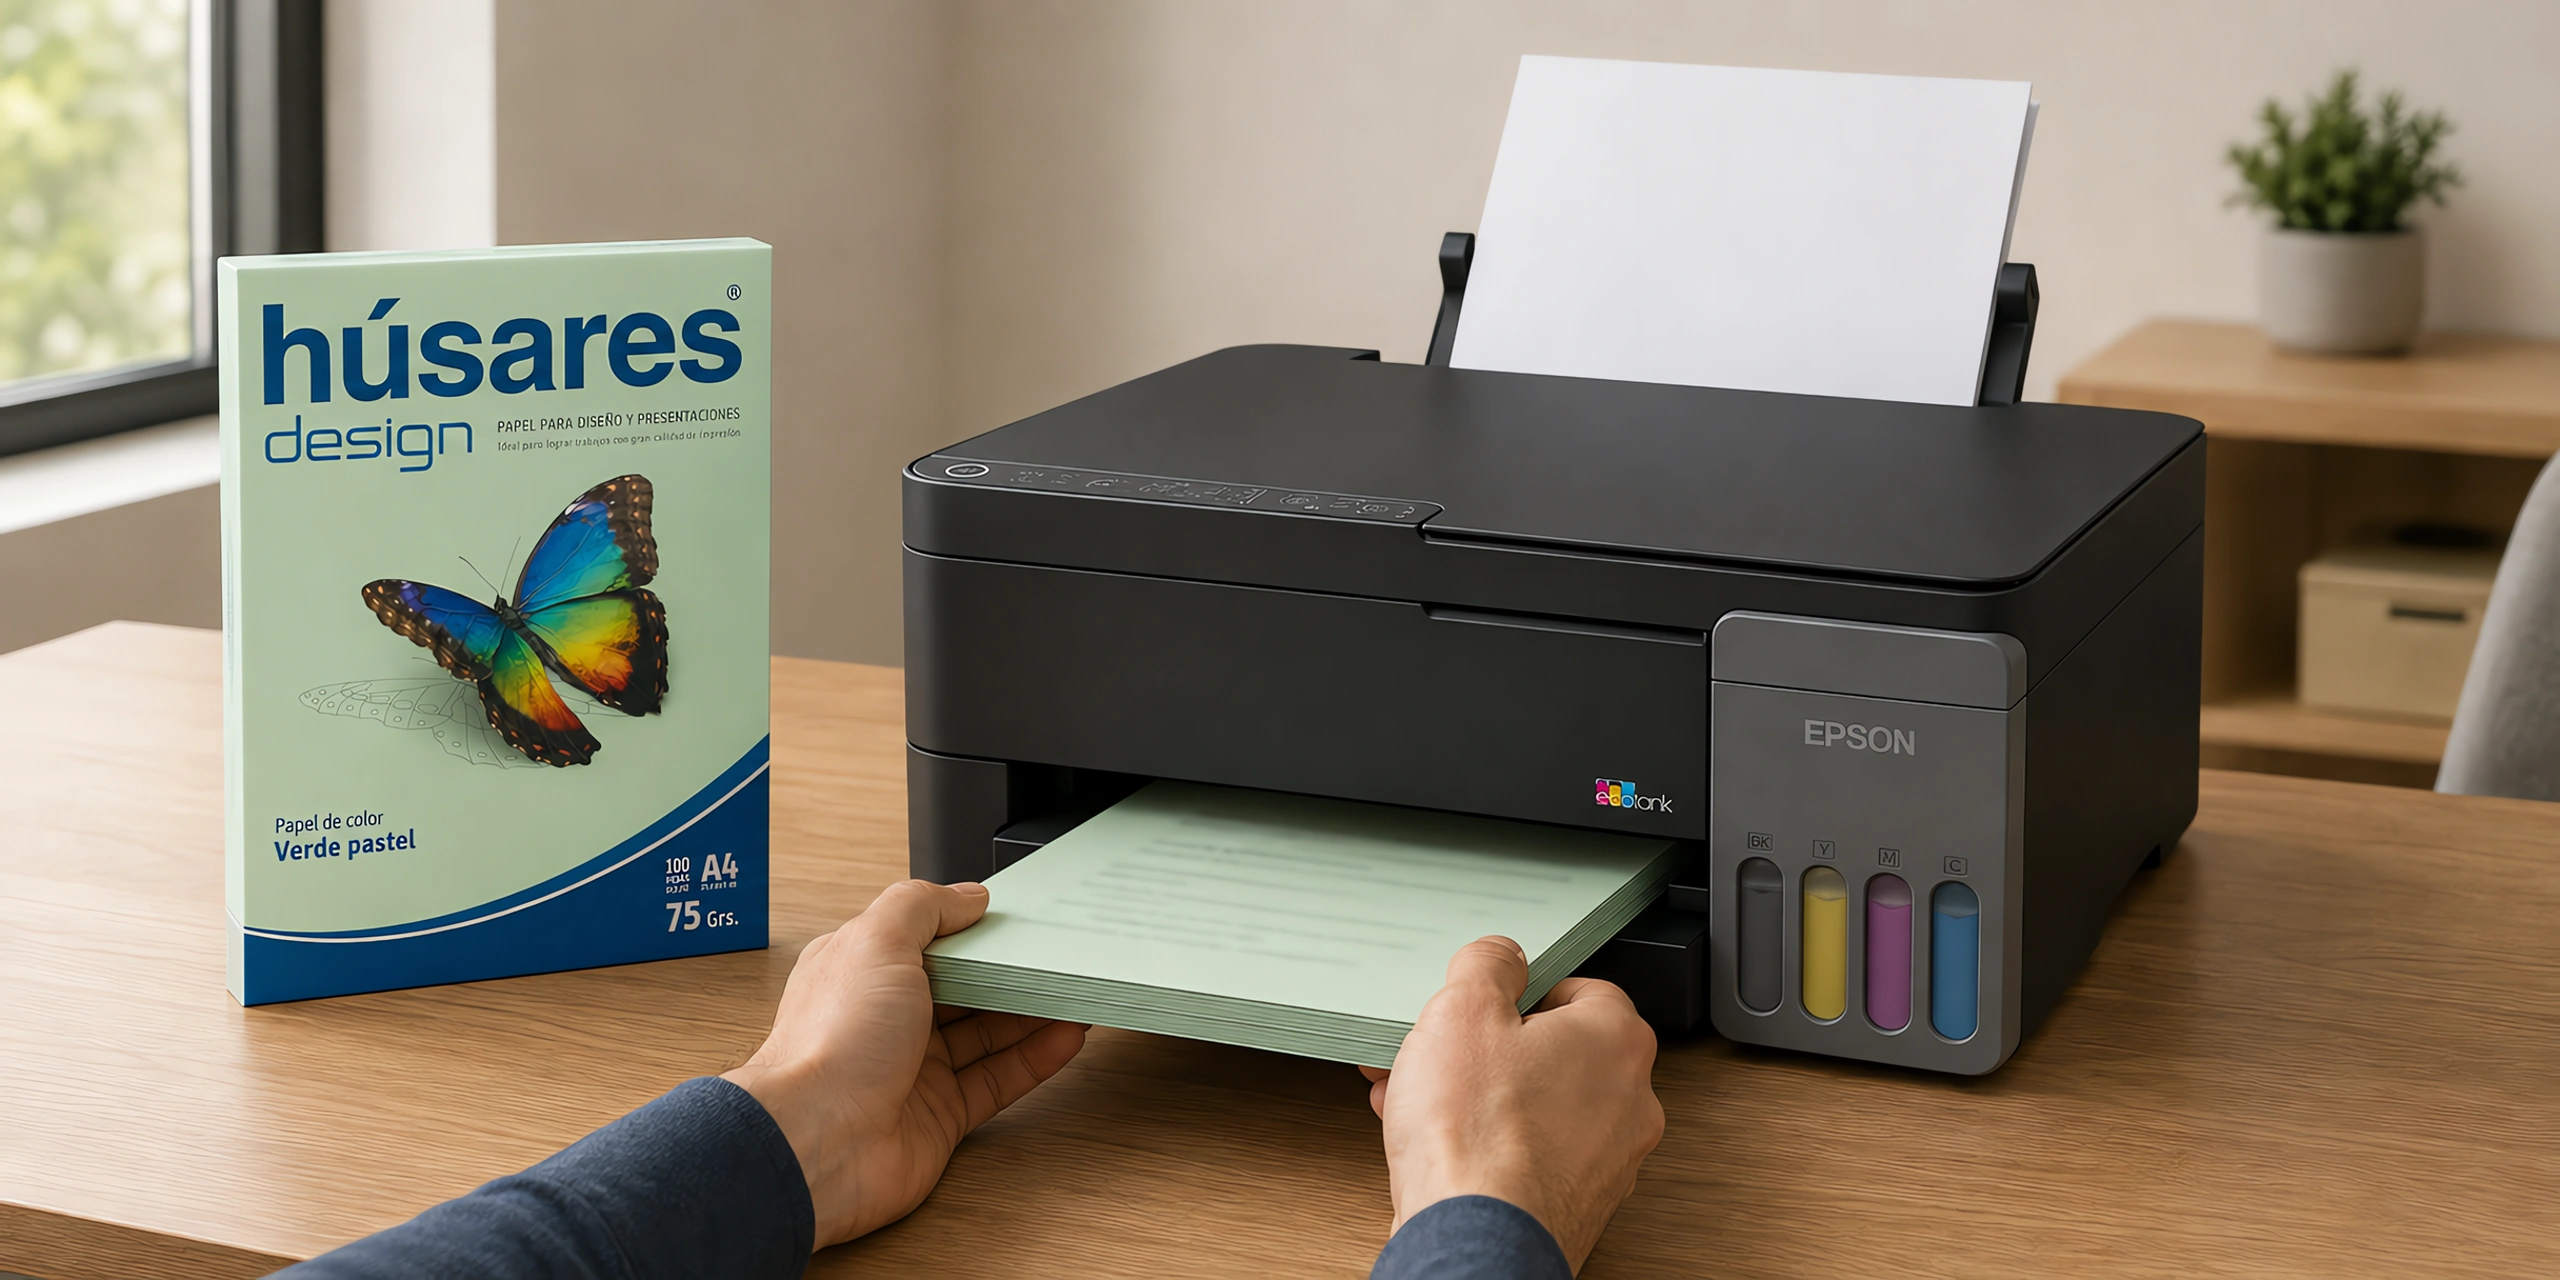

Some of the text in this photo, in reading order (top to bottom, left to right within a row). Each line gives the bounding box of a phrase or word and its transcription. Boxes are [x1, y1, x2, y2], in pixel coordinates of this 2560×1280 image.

[263, 298, 742, 405] húsares
[497, 407, 741, 433] PAPEL PARA DISEÑO Y PRESENTACIONES
[264, 415, 473, 473] design
[1804, 719, 1915, 756] EPSON
[275, 810, 384, 836] Papel de color
[274, 828, 416, 862] Verde pastel
[1819, 843, 1830, 856] Y
[1882, 852, 1897, 865] M
[1948, 859, 1962, 872] C
[666, 856, 690, 874] 100
[701, 852, 739, 882] A4
[666, 900, 739, 932] 75 Grs.
